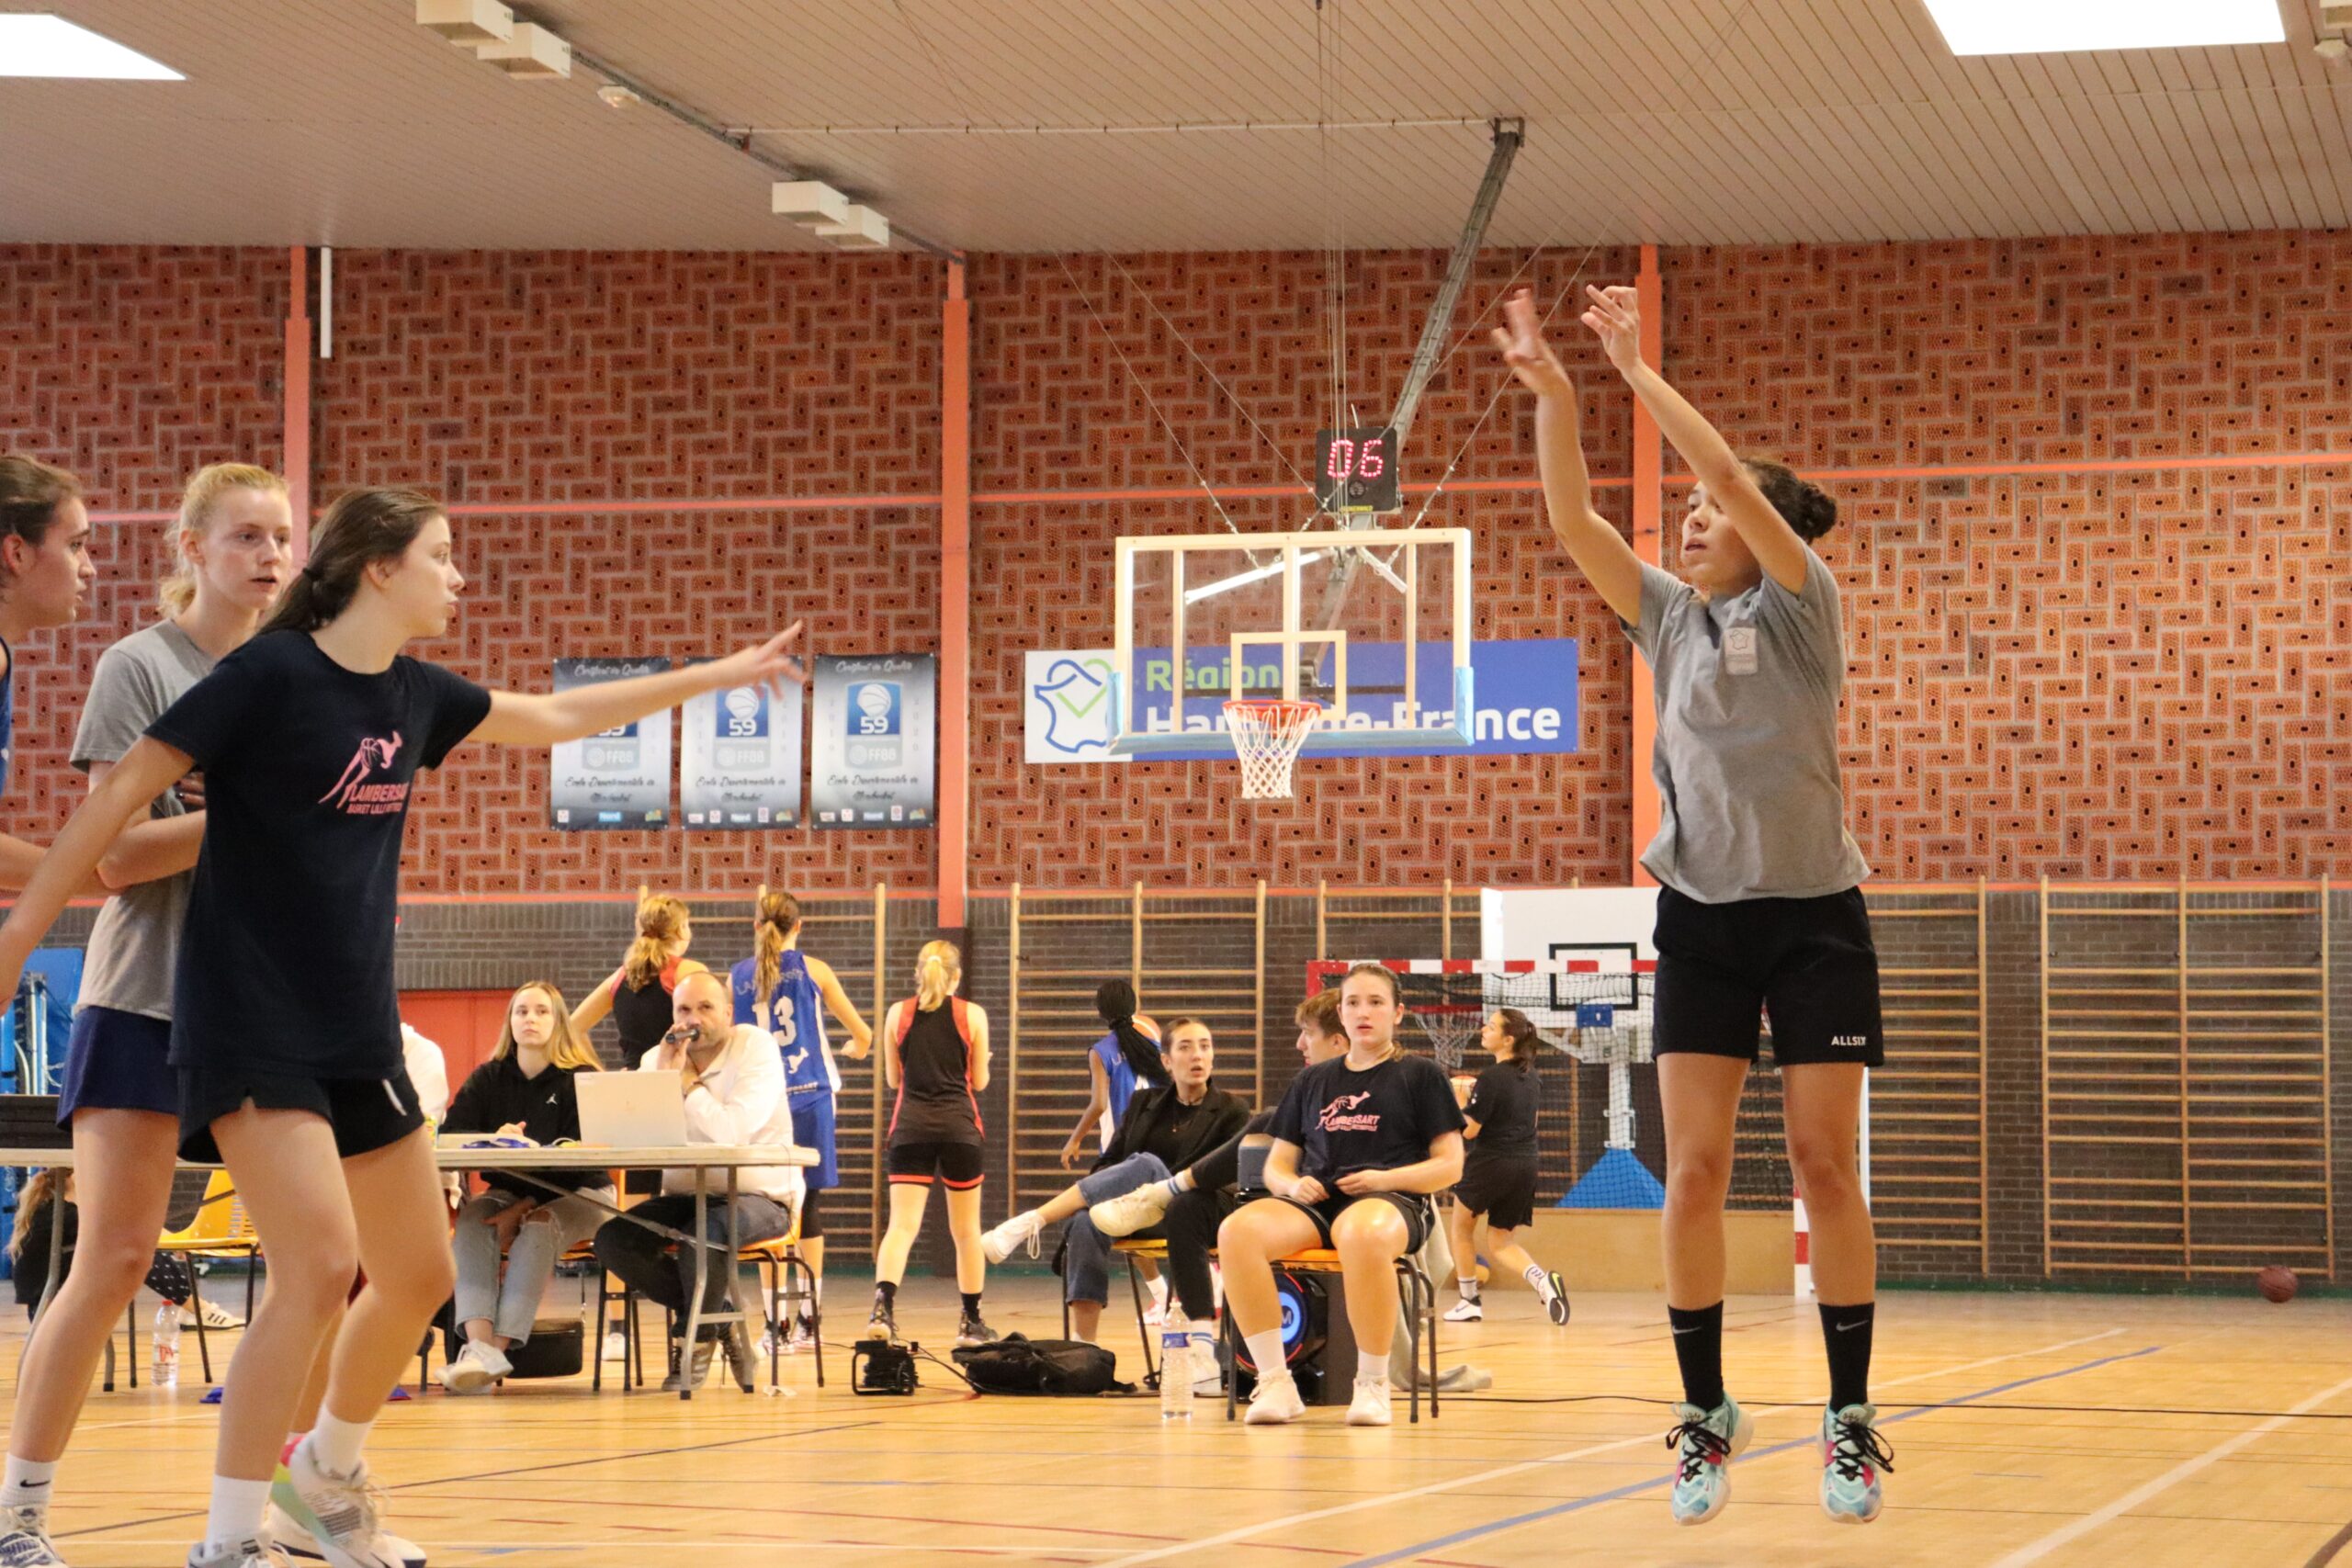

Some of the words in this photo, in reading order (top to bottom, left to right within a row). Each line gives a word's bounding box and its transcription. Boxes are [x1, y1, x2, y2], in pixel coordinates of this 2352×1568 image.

[1327, 439, 1384, 478] 06
[729, 717, 757, 737] 59
[860, 716, 888, 735] 59
[751, 995, 797, 1047] 13
